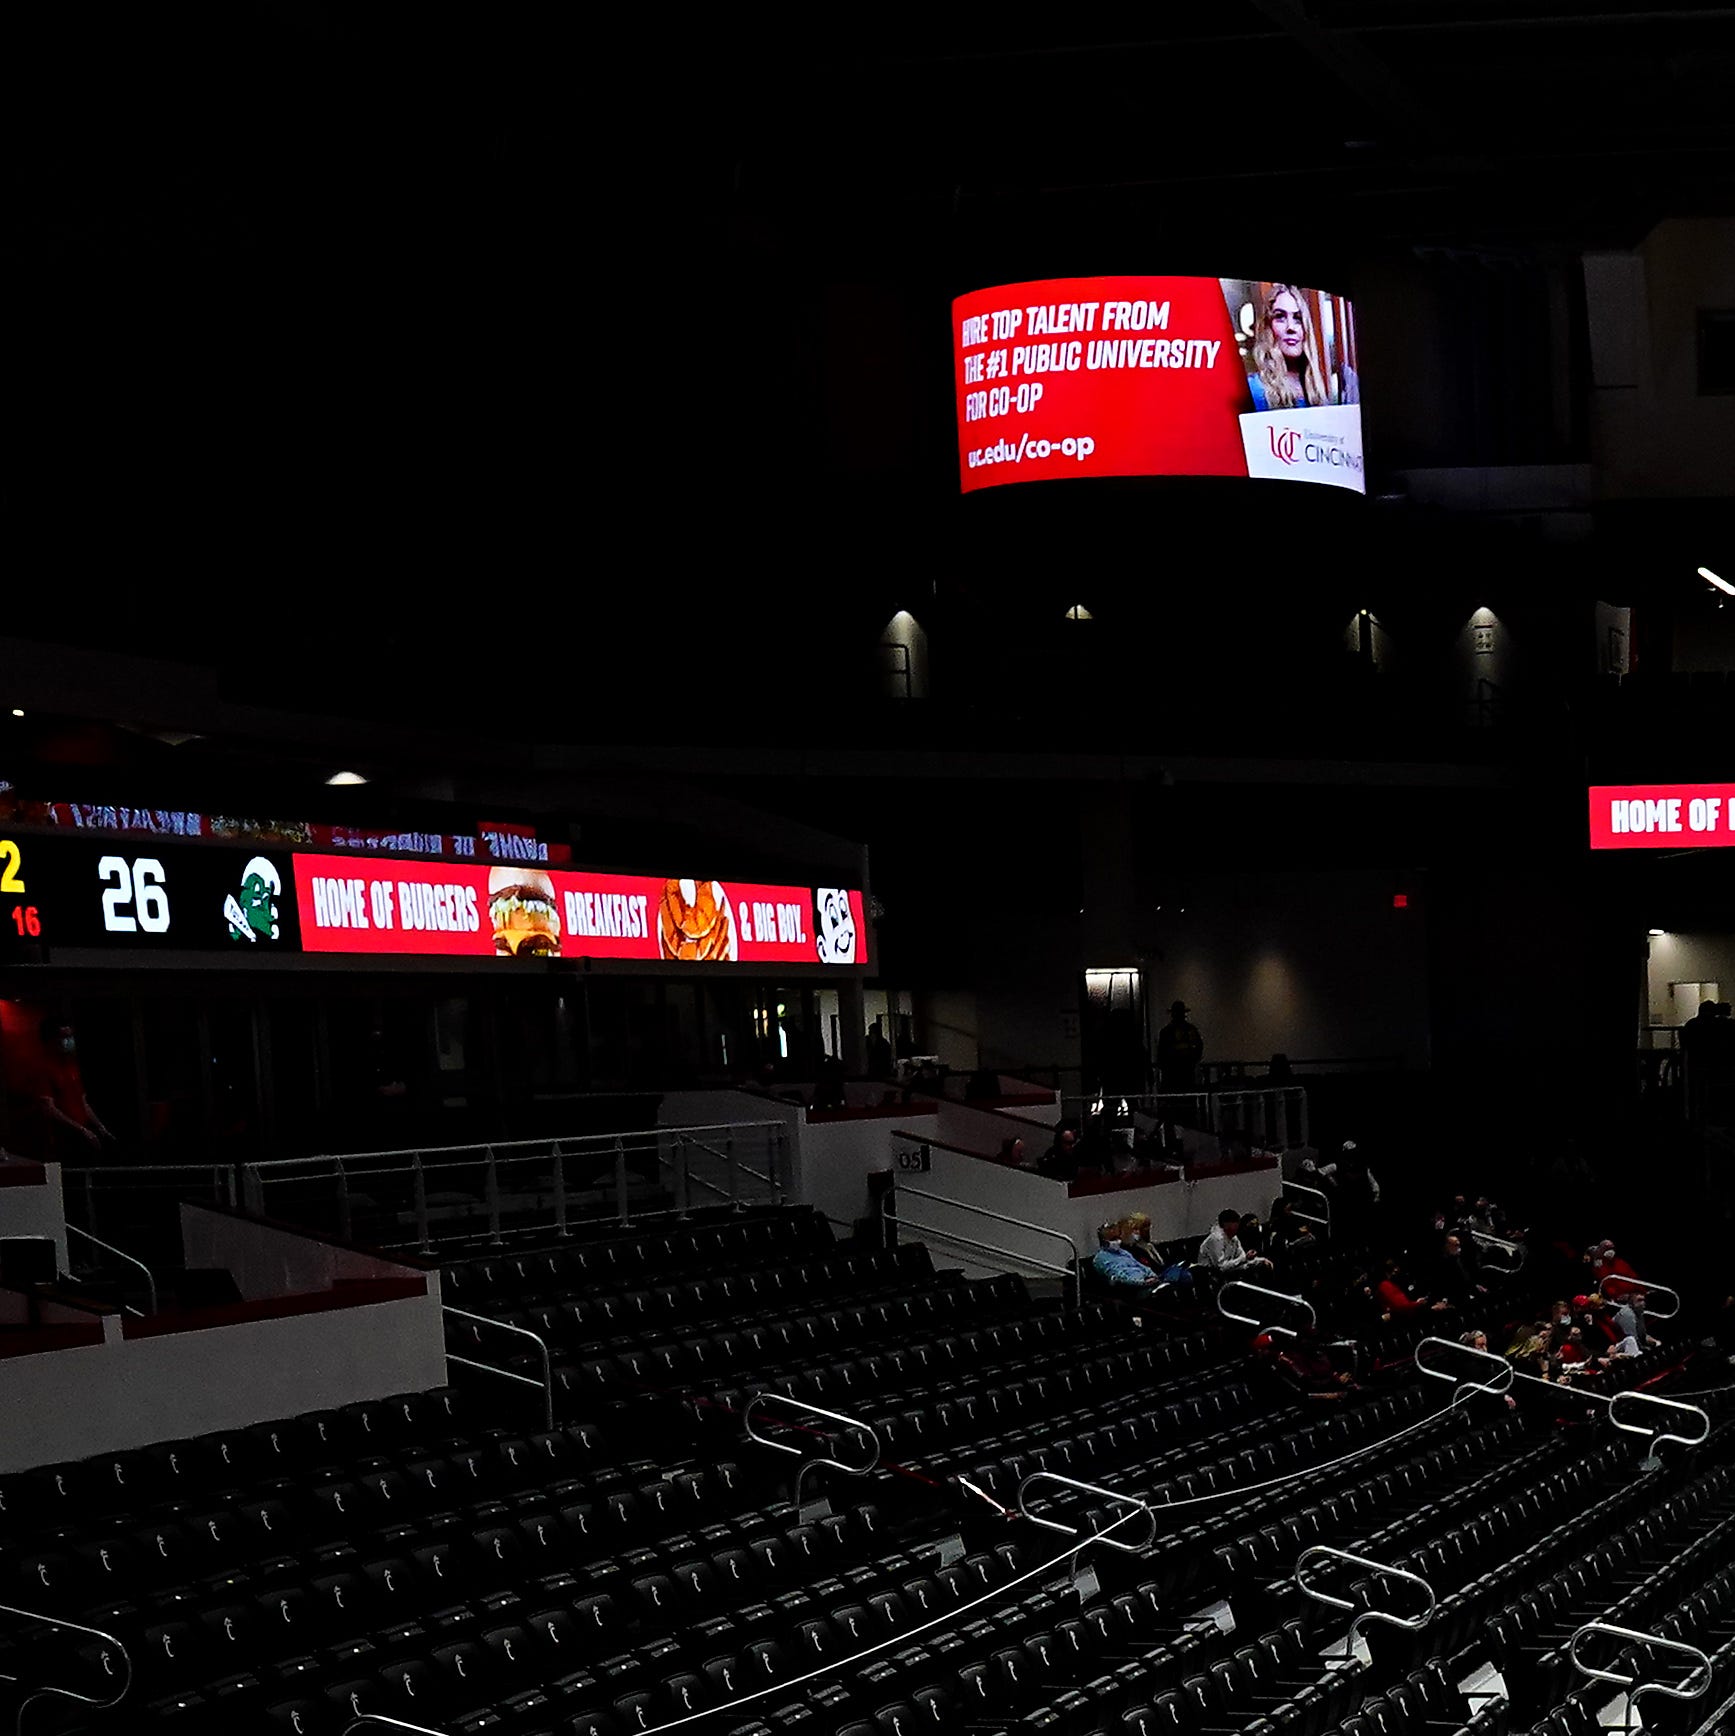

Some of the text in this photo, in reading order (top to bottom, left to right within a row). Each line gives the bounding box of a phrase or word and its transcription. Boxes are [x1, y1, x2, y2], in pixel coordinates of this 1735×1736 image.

[962, 300, 1171, 348] HIRE TOP TALENT FROM
[965, 340, 1221, 385] THE #1 PUBLIC UNIVERSITY
[966, 382, 1043, 422] FOR CO-OP
[968, 433, 1095, 469] uc.edu/co-op
[1611, 802, 1682, 833] HOME
[1689, 800, 1720, 831] OF
[99, 856, 170, 933] 26
[312, 877, 806, 944] HOME OF BURGERS BREAKFAST & BIG BOY.
[12, 906, 41, 937] 16
